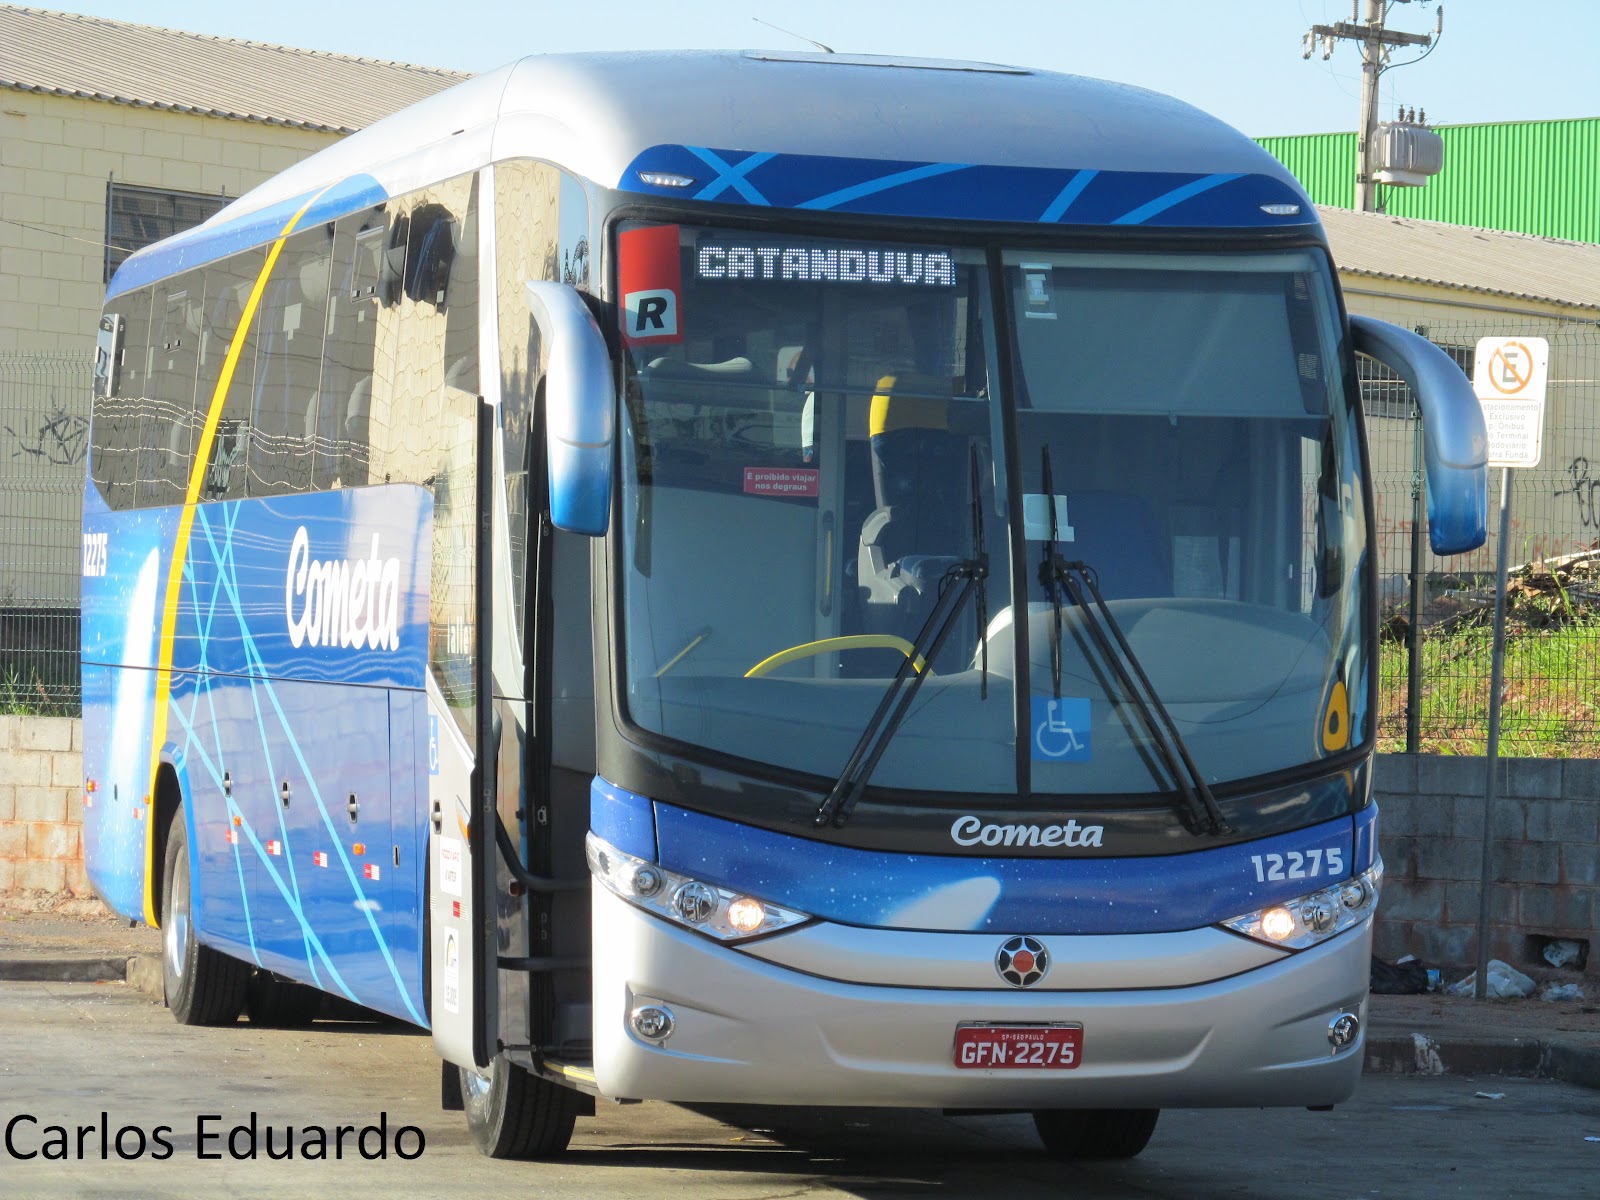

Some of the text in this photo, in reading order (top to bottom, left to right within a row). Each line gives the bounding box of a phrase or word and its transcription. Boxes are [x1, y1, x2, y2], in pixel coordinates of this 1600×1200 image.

[699, 247, 956, 285] CATANDUVA
[635, 296, 668, 332] R
[1480, 403, 1539, 411] stacionamento
[1489, 412, 1526, 421] Exclusivo
[1496, 431, 1529, 440] Terminal
[1504, 450, 1529, 459] Funda
[755, 472, 790, 481] proibido
[792, 474, 816, 483] viajar
[772, 482, 808, 492] degraus
[83, 532, 108, 577] 12275
[286, 525, 400, 652] Cometa
[950, 815, 1105, 848] Cometa
[1251, 847, 1345, 883] 12275
